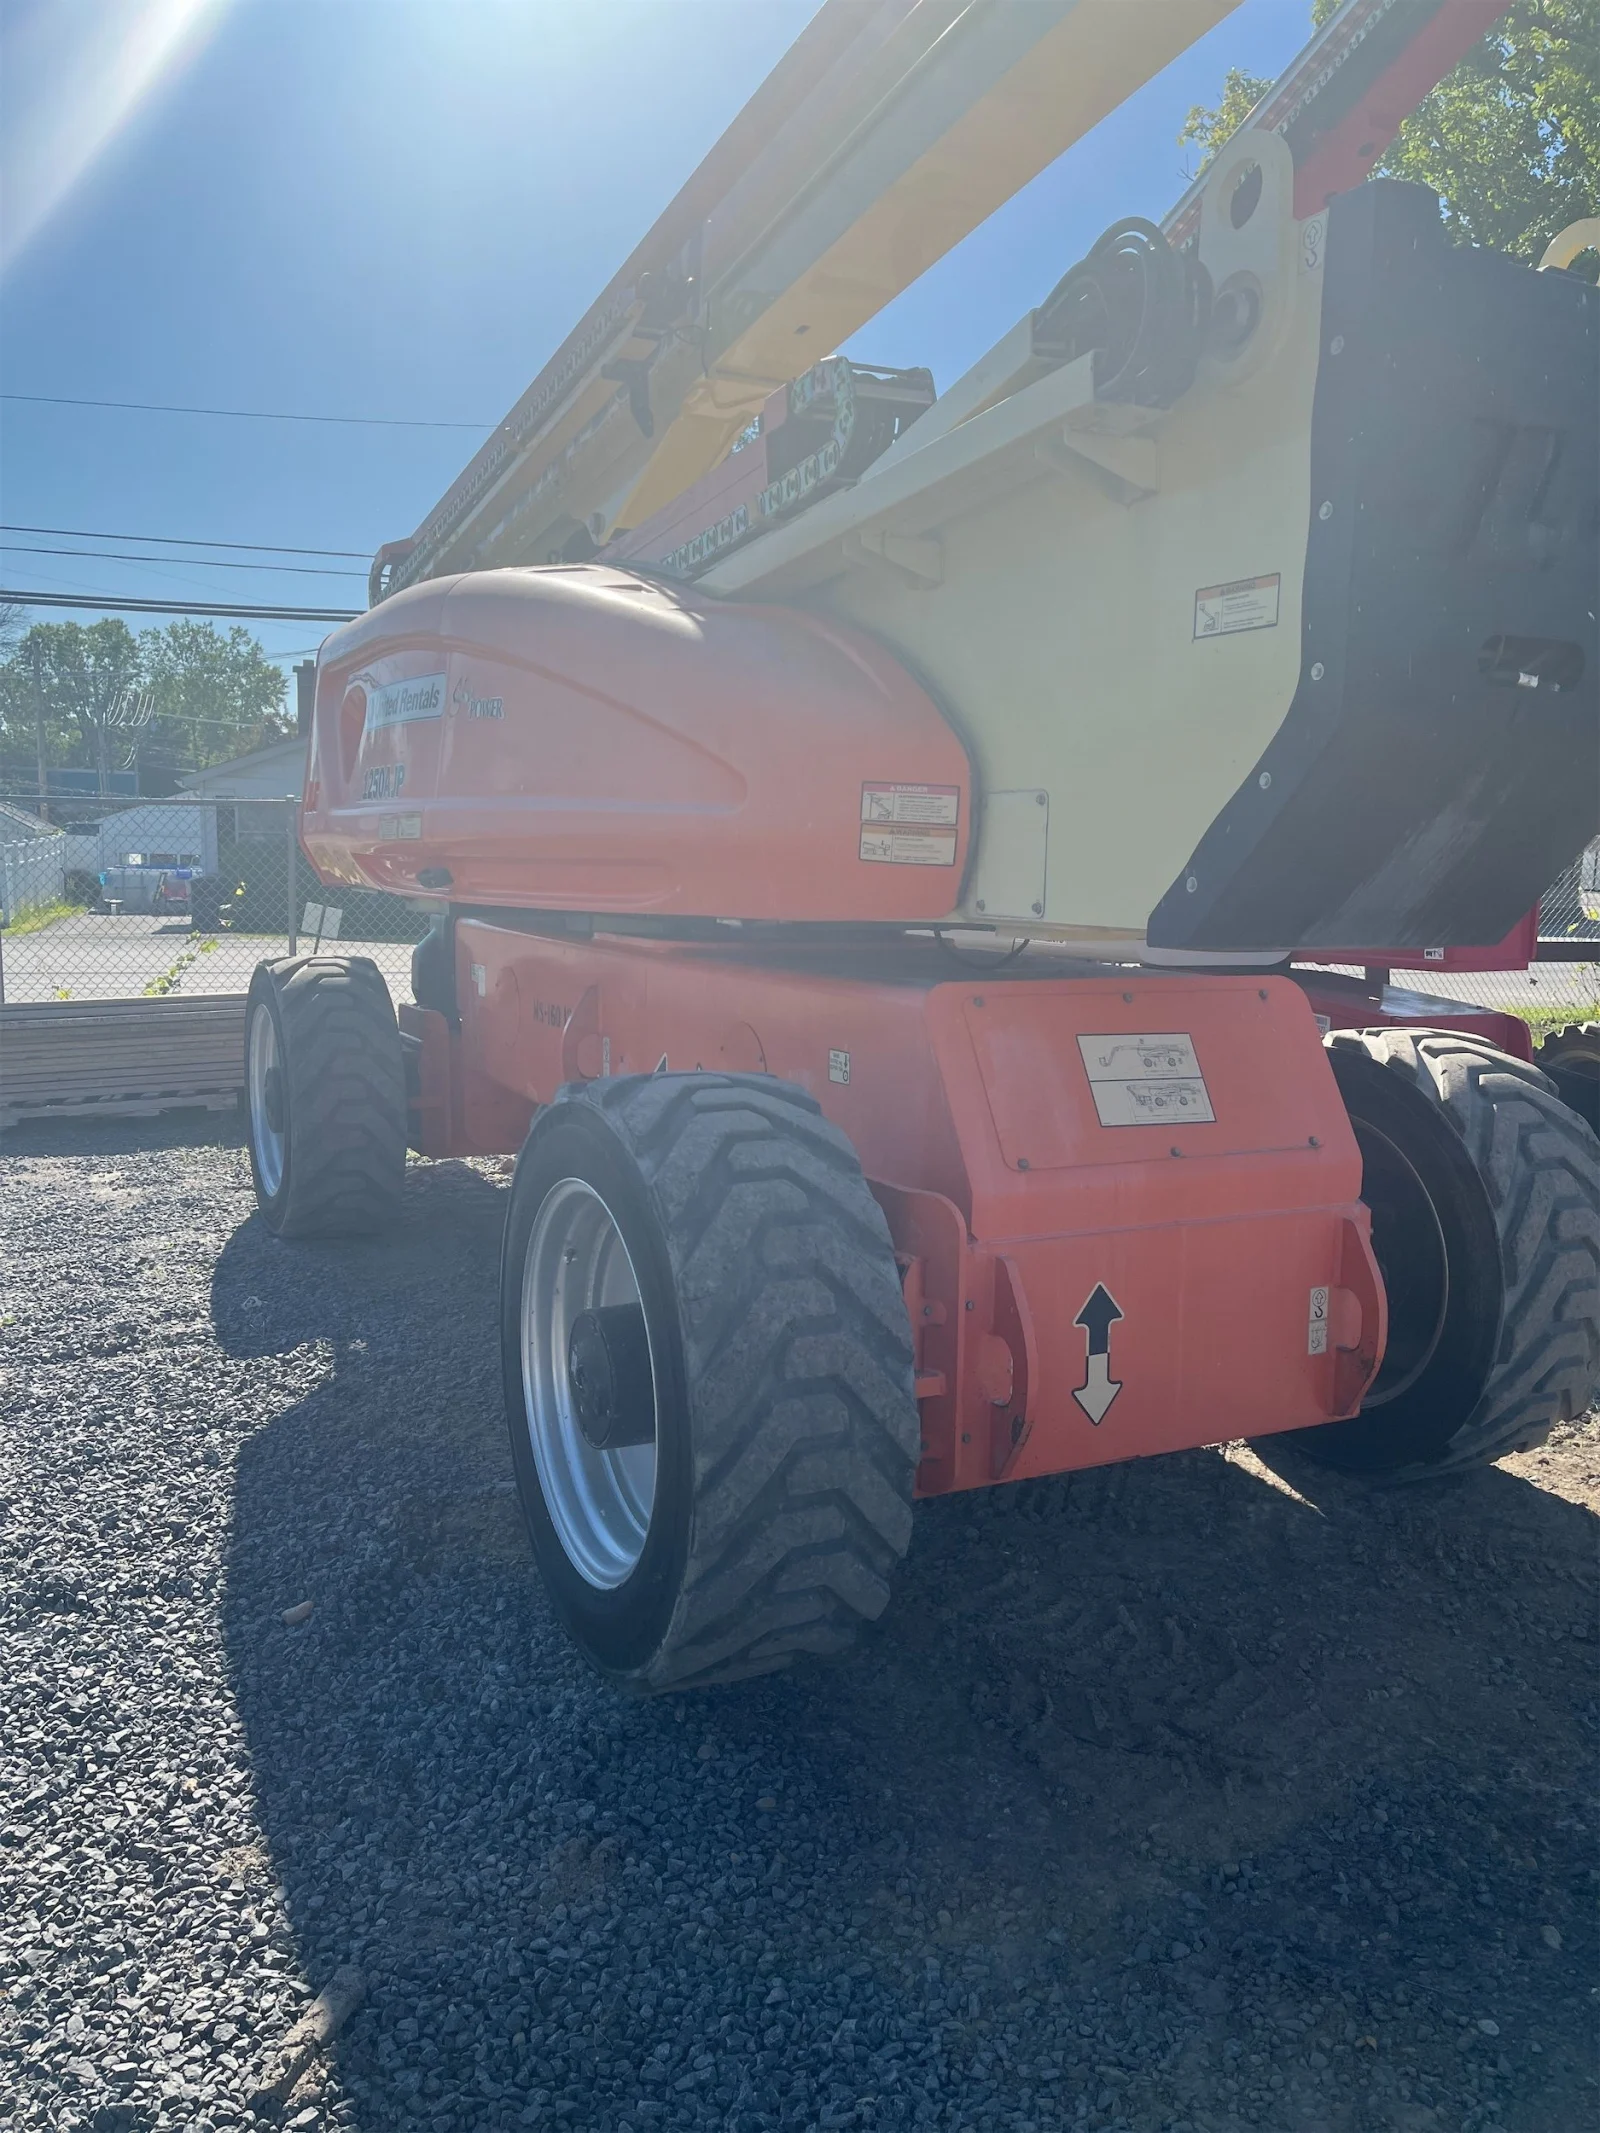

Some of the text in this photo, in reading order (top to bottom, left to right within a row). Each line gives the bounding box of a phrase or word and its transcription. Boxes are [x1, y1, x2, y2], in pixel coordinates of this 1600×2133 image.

[399, 682, 440, 713] Rentals
[469, 697, 504, 719] POWER
[896, 785, 928, 793] DANGER
